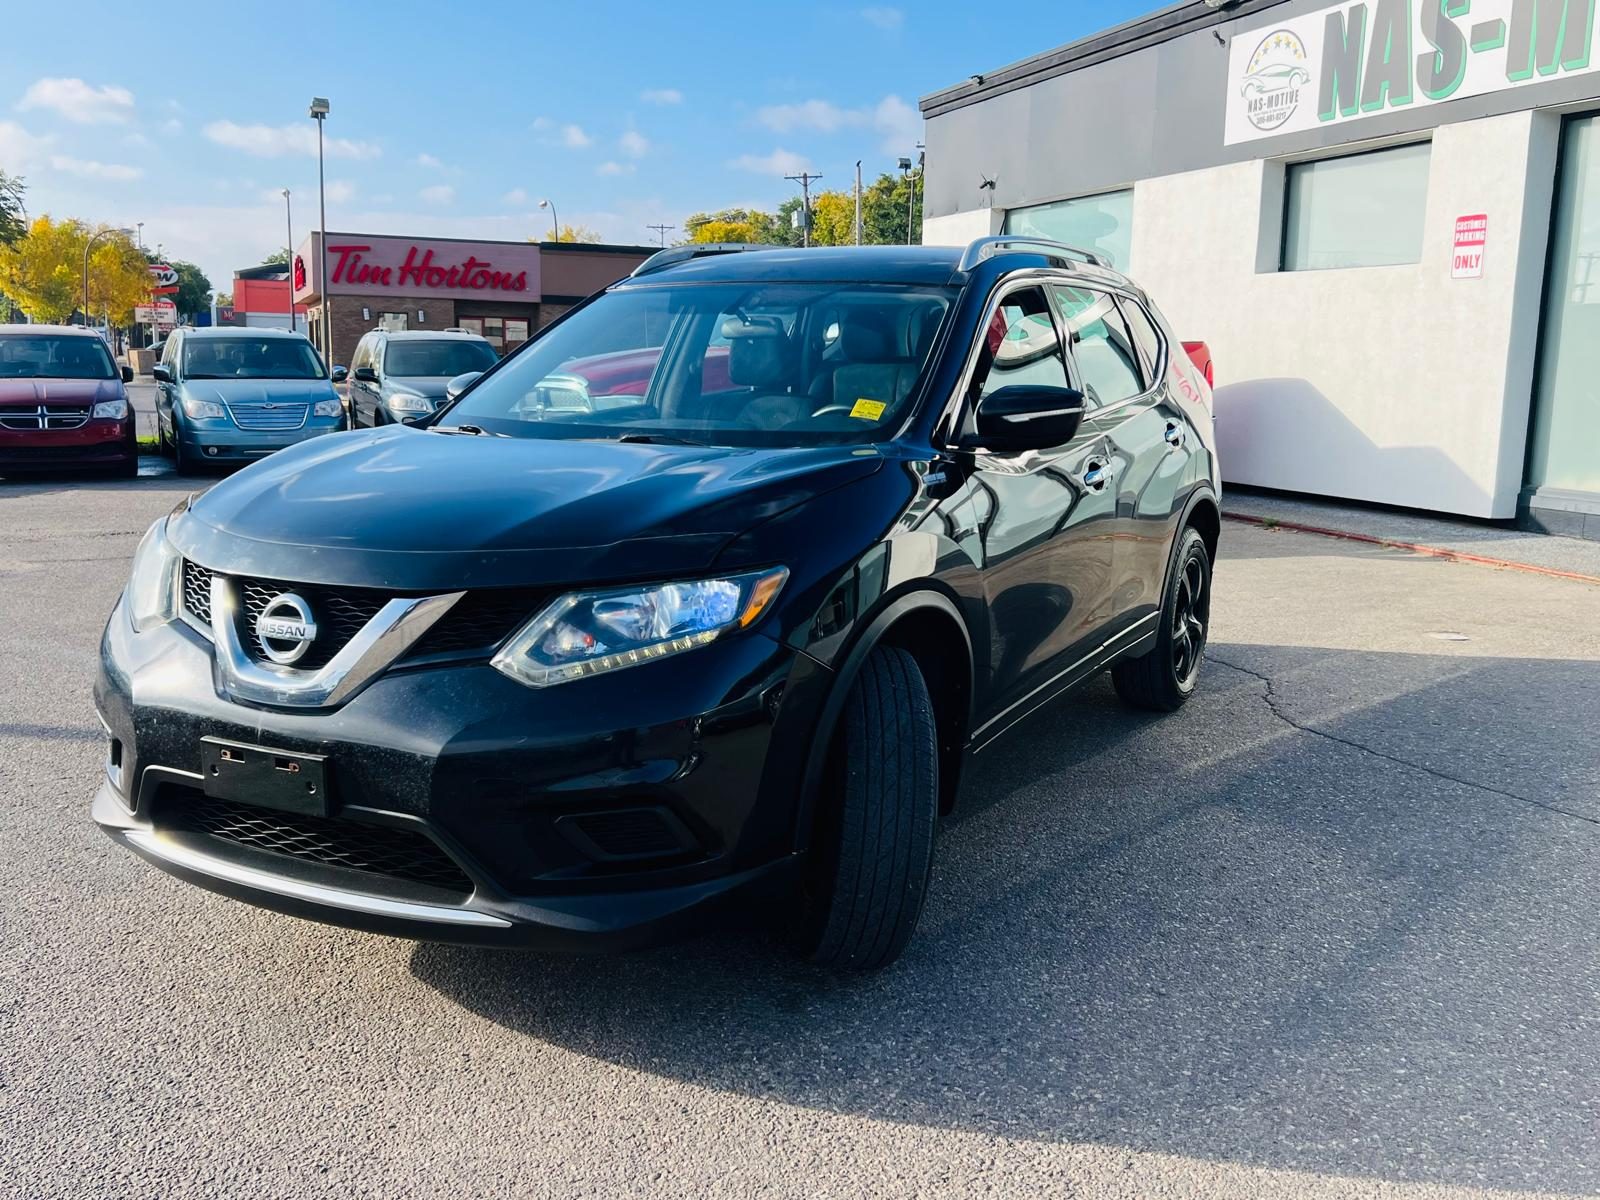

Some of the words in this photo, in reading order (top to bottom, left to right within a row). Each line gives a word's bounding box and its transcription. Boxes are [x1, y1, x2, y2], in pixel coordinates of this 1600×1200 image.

[1248, 89, 1299, 113] NAS-MOTIVE
[1456, 219, 1486, 231] CUSTOMER
[1455, 230, 1485, 243] PARKING
[327, 245, 393, 286] Tim
[398, 246, 527, 292] Hortons
[1454, 254, 1481, 270] ONLY
[258, 622, 306, 637] NISSAN
